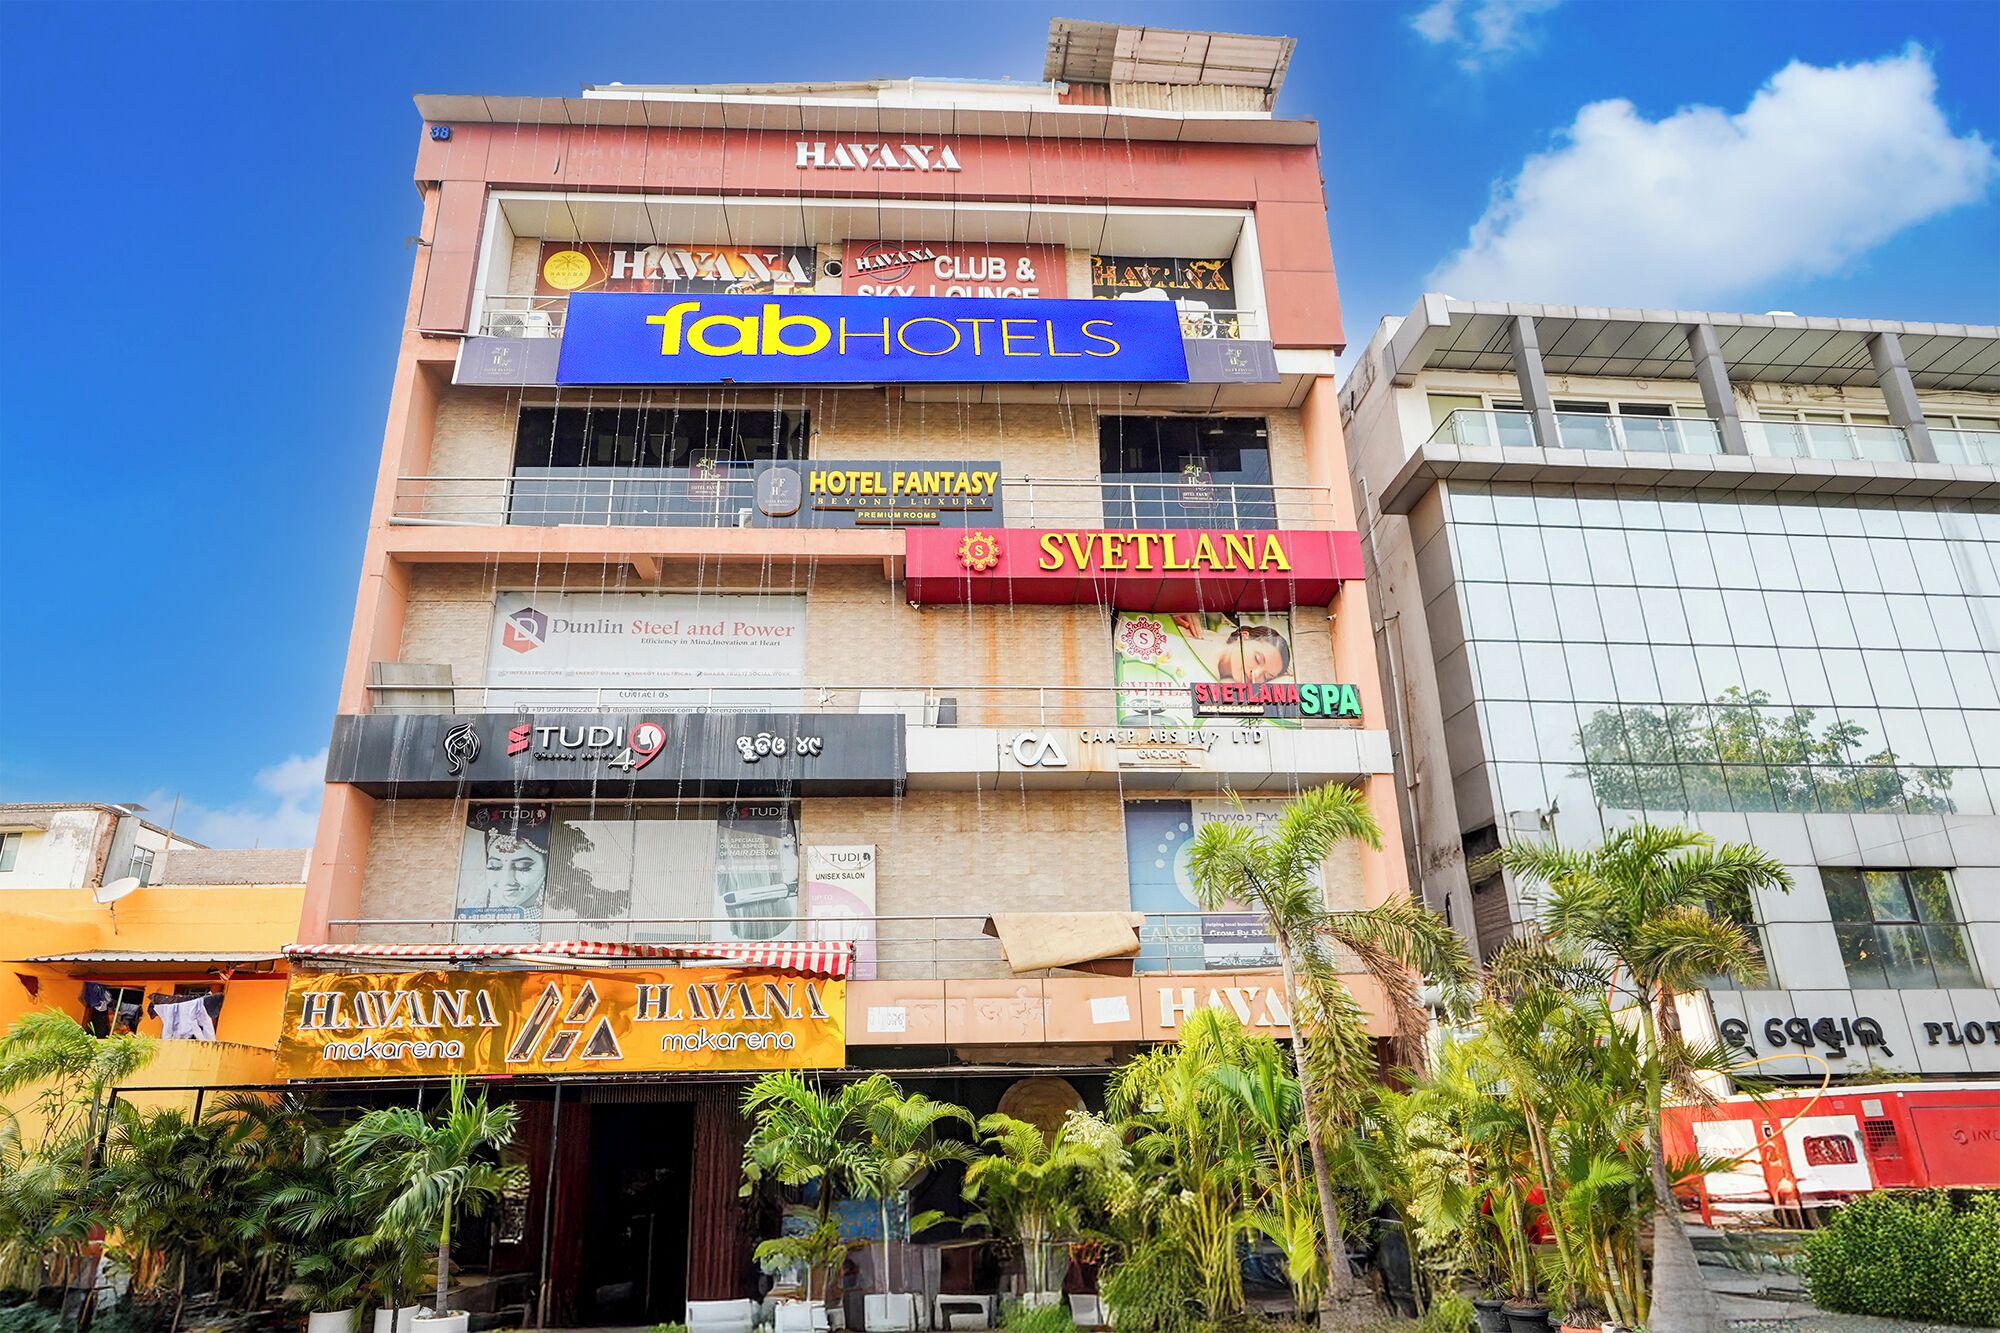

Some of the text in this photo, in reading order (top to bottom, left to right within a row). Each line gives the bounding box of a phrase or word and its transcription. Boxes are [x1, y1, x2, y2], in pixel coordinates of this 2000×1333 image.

[430, 125, 451, 141] 38
[795, 141, 962, 173] HAVANA
[610, 250, 812, 284] HAVANA
[854, 247, 937, 272] HAVANA
[934, 255, 1036, 282] CLUB &
[809, 471, 999, 497] HOTEL FANTASY
[817, 498, 988, 506] BEYOND LUXURY
[858, 511, 902, 519] PREMIUM
[1038, 533, 1293, 572] SVETLANA
[552, 618, 796, 638] Dunlin Steel and Power
[1120, 681, 1190, 697] SVETLA
[1196, 683, 1361, 716] SVETLANA SPA
[1149, 729, 1178, 744] ABS
[1232, 731, 1263, 744] LTD
[815, 872, 866, 881] UNISEX SALON
[1140, 926, 1203, 943] CAASP
[299, 988, 502, 1030] HAVANA
[634, 983, 830, 1021] HAVANA
[1158, 987, 1305, 1028] HAVA
[322, 1040, 465, 1061] makarena
[661, 1027, 796, 1053] makarena
